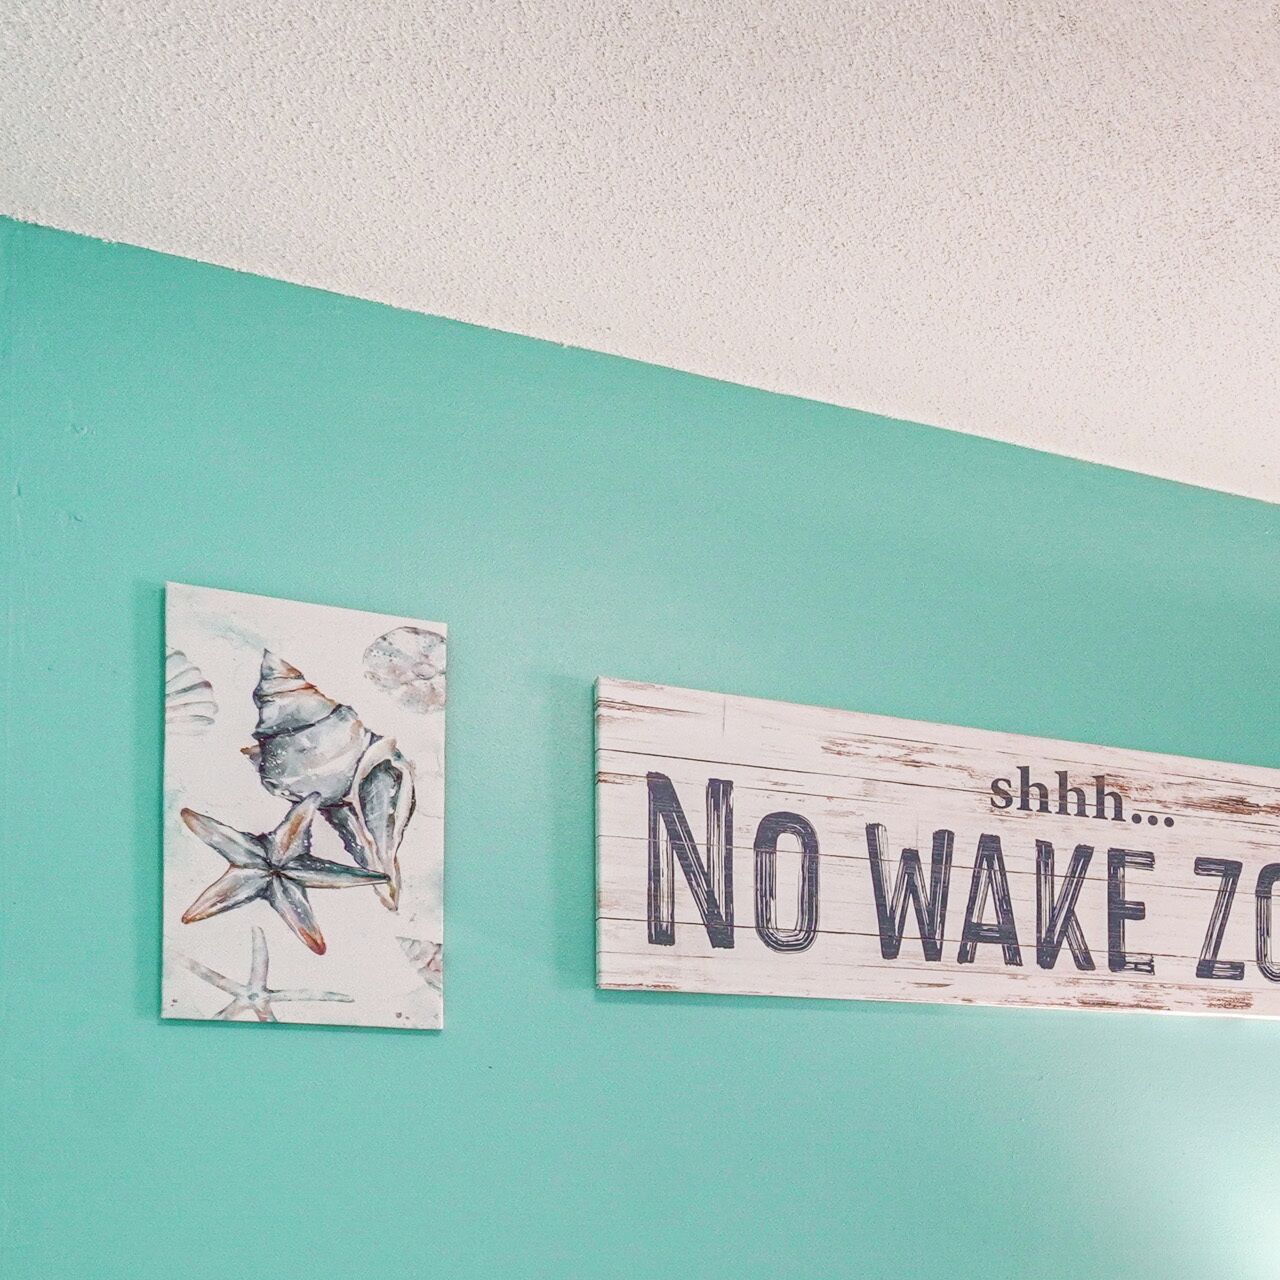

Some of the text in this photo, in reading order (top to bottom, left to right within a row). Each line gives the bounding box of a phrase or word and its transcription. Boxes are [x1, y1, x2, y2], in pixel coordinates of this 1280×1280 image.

[989, 766, 1176, 828] shhh...
[646, 770, 821, 954] NO
[865, 822, 1156, 974] WAKE
